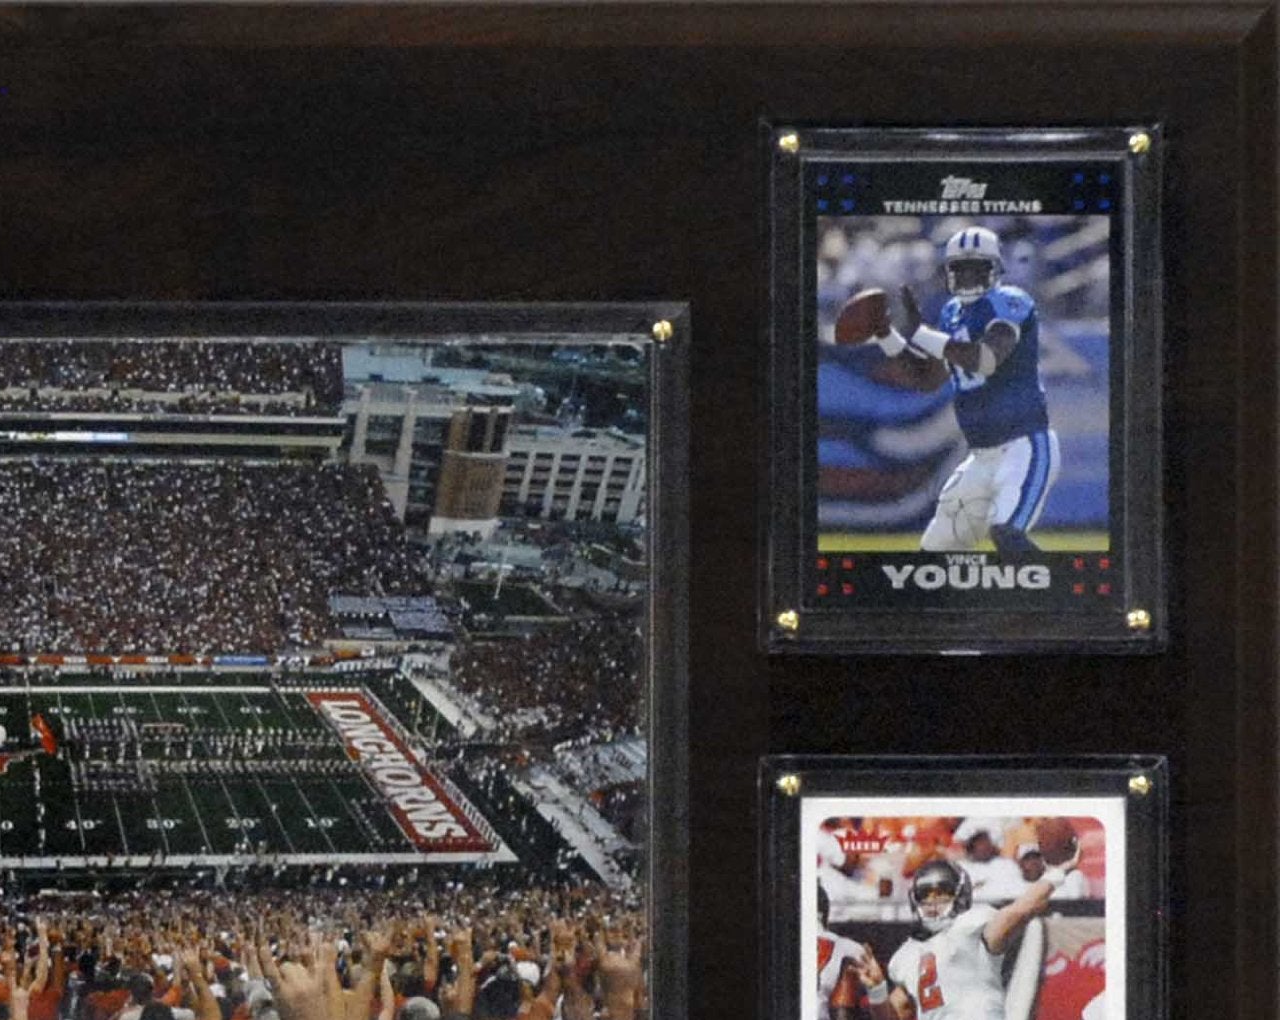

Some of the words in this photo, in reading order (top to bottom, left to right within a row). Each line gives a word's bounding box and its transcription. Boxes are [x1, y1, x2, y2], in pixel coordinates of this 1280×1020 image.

[883, 200, 980, 213] TENNESSEE
[983, 200, 1043, 213] TITANS
[882, 564, 1051, 590] YOUNG
[320, 700, 469, 839] LONGHORNS
[917, 952, 945, 1014] 2
